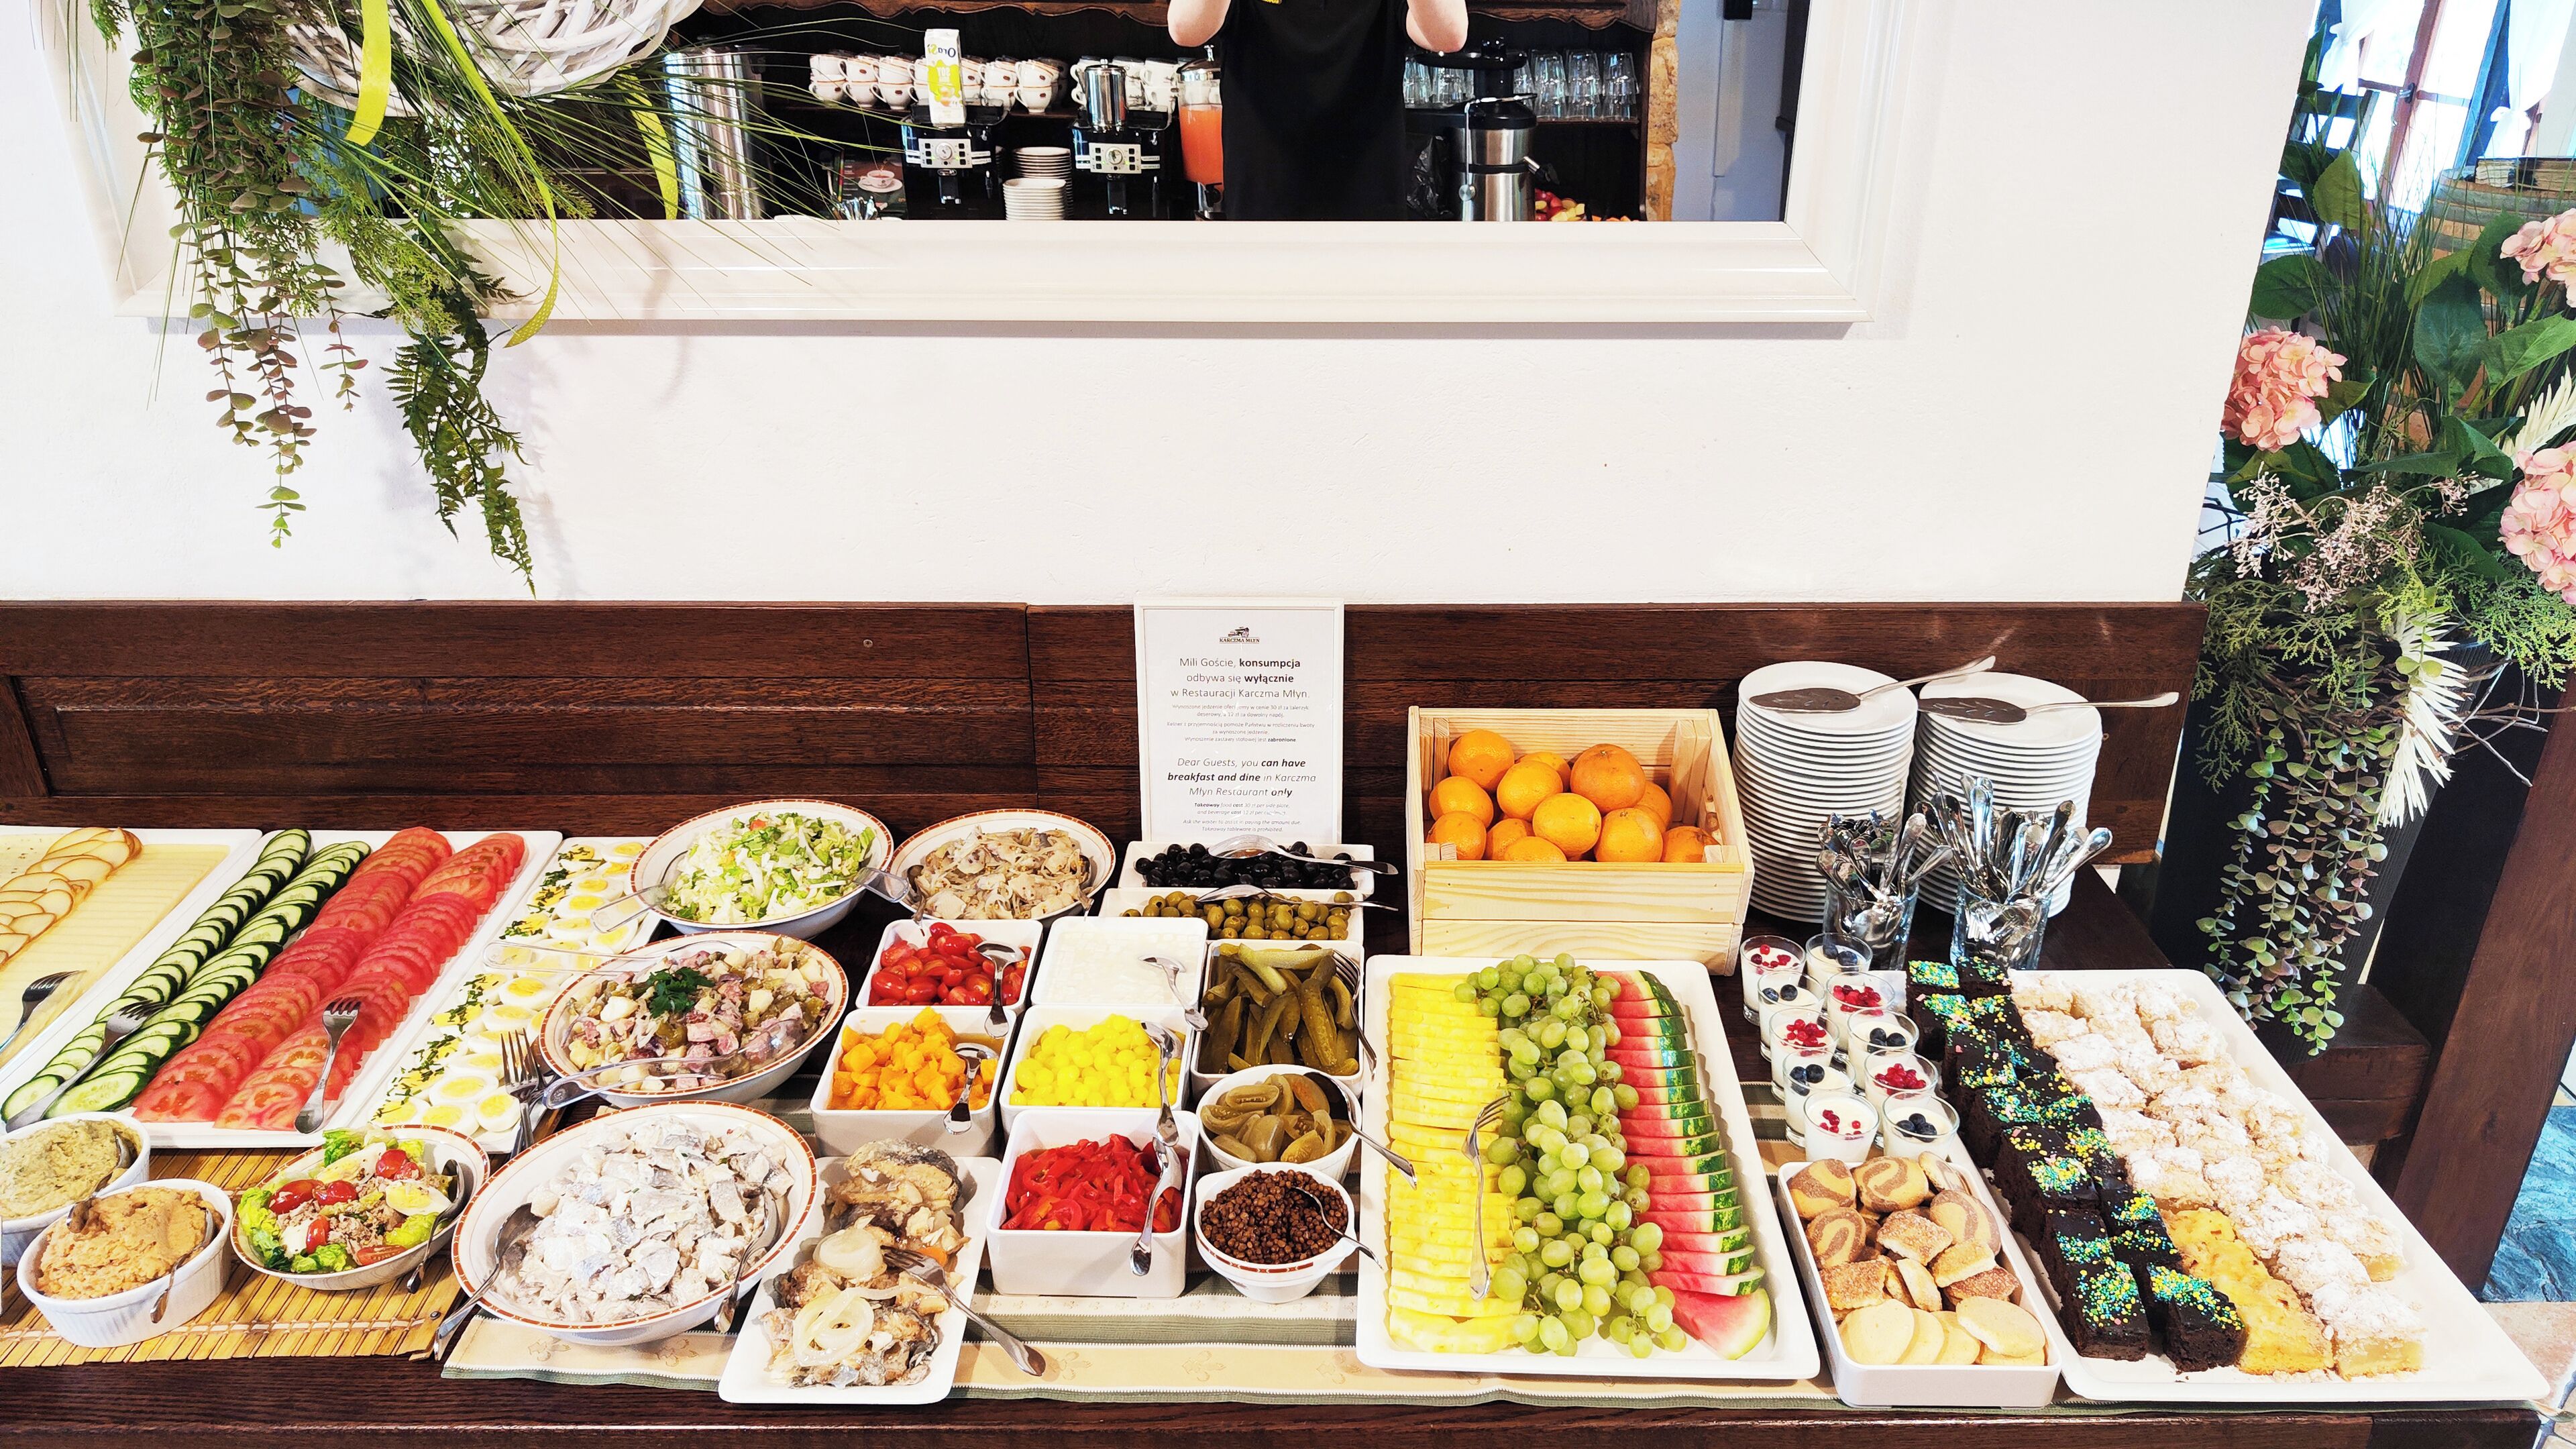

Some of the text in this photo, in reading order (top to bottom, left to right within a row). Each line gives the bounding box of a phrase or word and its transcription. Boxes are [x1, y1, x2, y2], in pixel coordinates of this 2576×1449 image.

[1179, 657, 1301, 669] Mili Goście, konsumpcja
[1186, 673, 1294, 684] odbywa się wyłącznie
[1182, 688, 1236, 698] Restauracji
[1238, 689, 1279, 698] Karczma
[1283, 689, 1310, 700] Młyn.
[1177, 757, 1306, 769] Dear Guests, you can have
[1168, 773, 1316, 783] breakfast and dine in Karczma
[1189, 787, 1293, 798] Młyn Restaurant only
